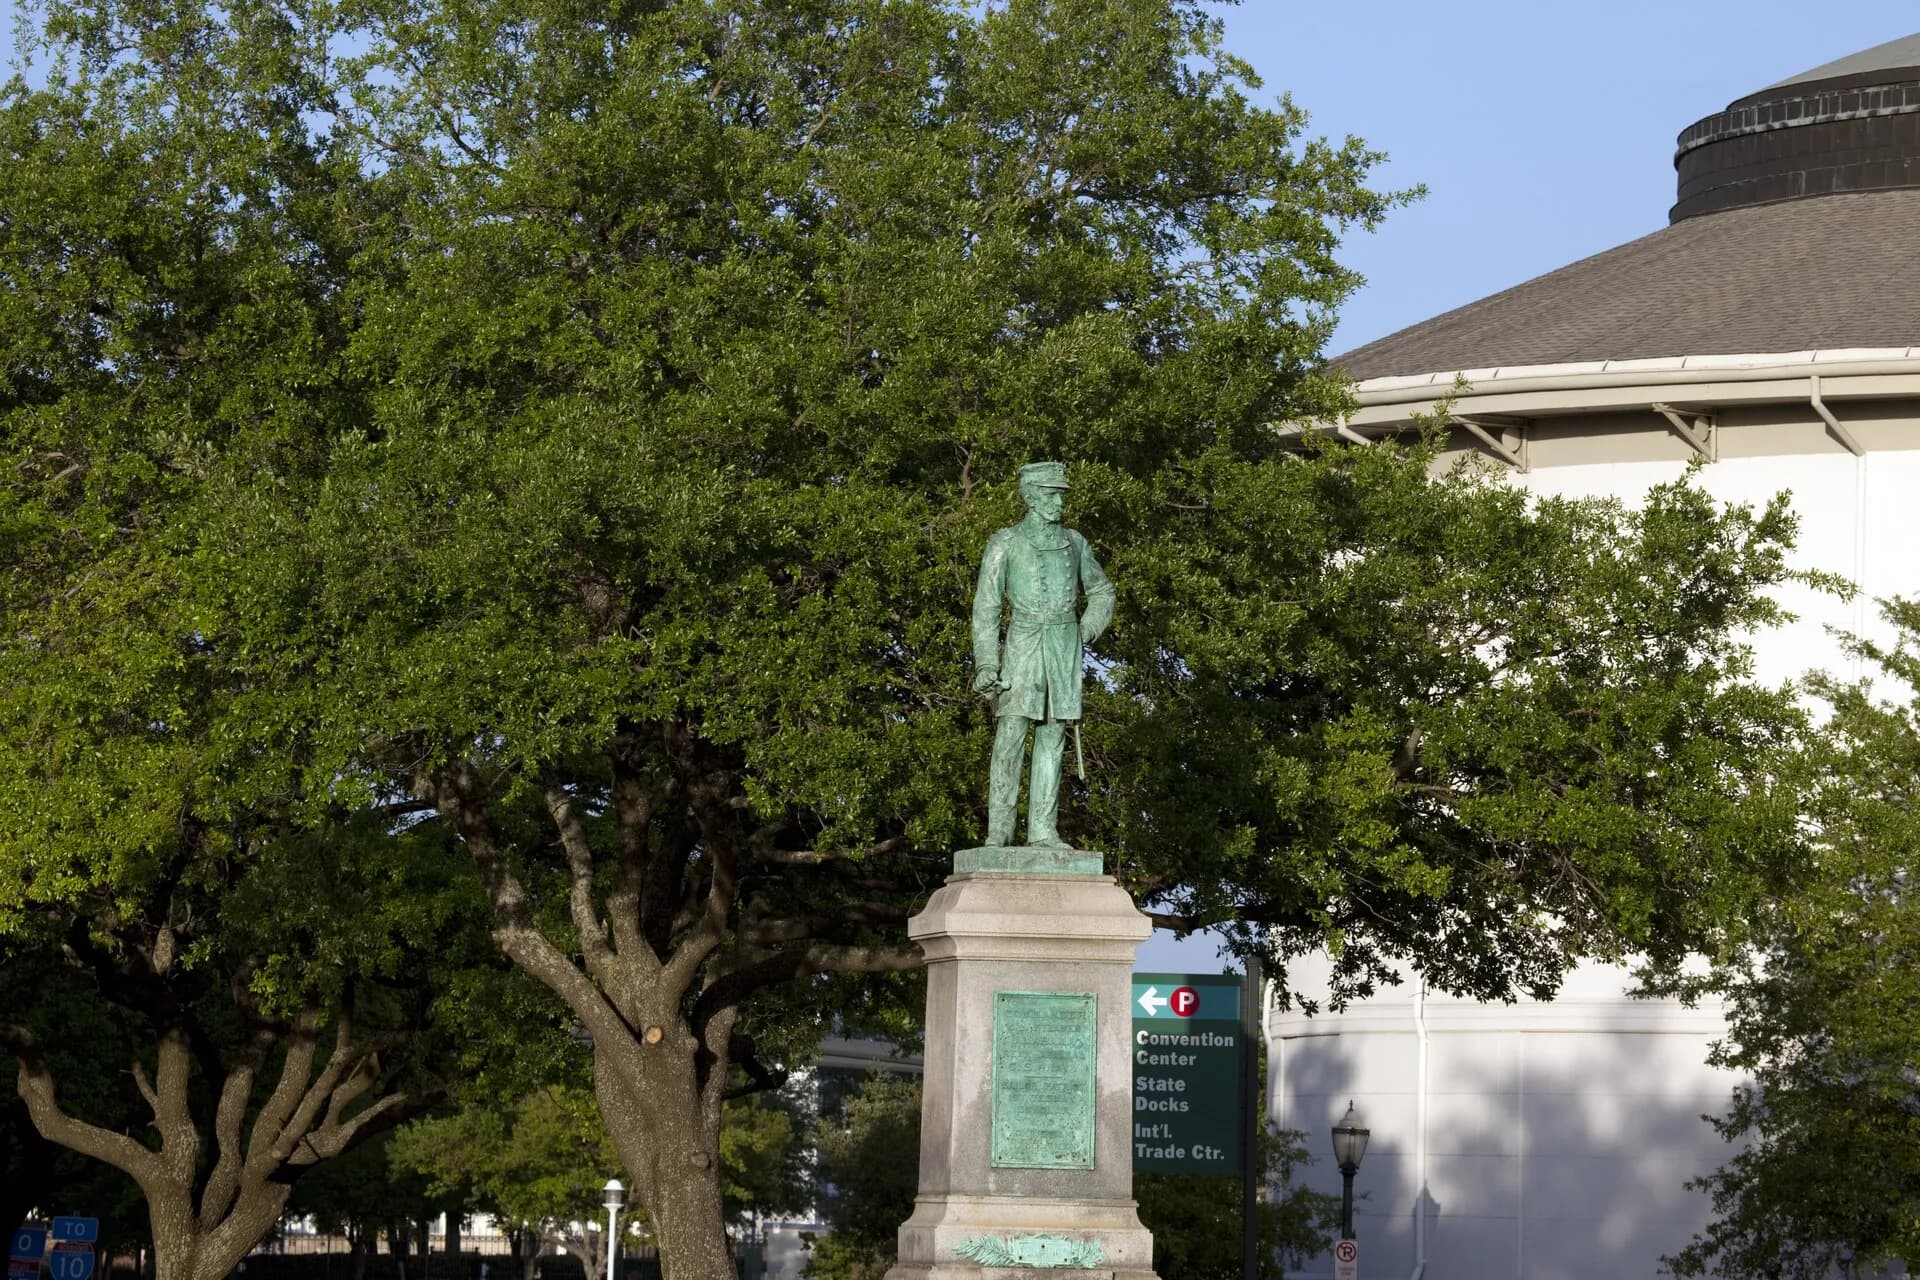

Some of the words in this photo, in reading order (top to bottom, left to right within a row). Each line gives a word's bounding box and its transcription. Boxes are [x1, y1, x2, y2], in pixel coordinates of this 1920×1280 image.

[1178, 992, 1195, 1012] P
[1136, 1030, 1234, 1047] Convention
[1136, 1050, 1197, 1066] Center
[1136, 1076, 1186, 1092] State
[1135, 1097, 1190, 1112] Docks
[1135, 1123, 1173, 1139] Int'l.
[1135, 1144, 1185, 1159] Trade
[1192, 1145, 1225, 1160] Ctr.
[64, 1222, 86, 1237] TO
[60, 1257, 84, 1278] 10
